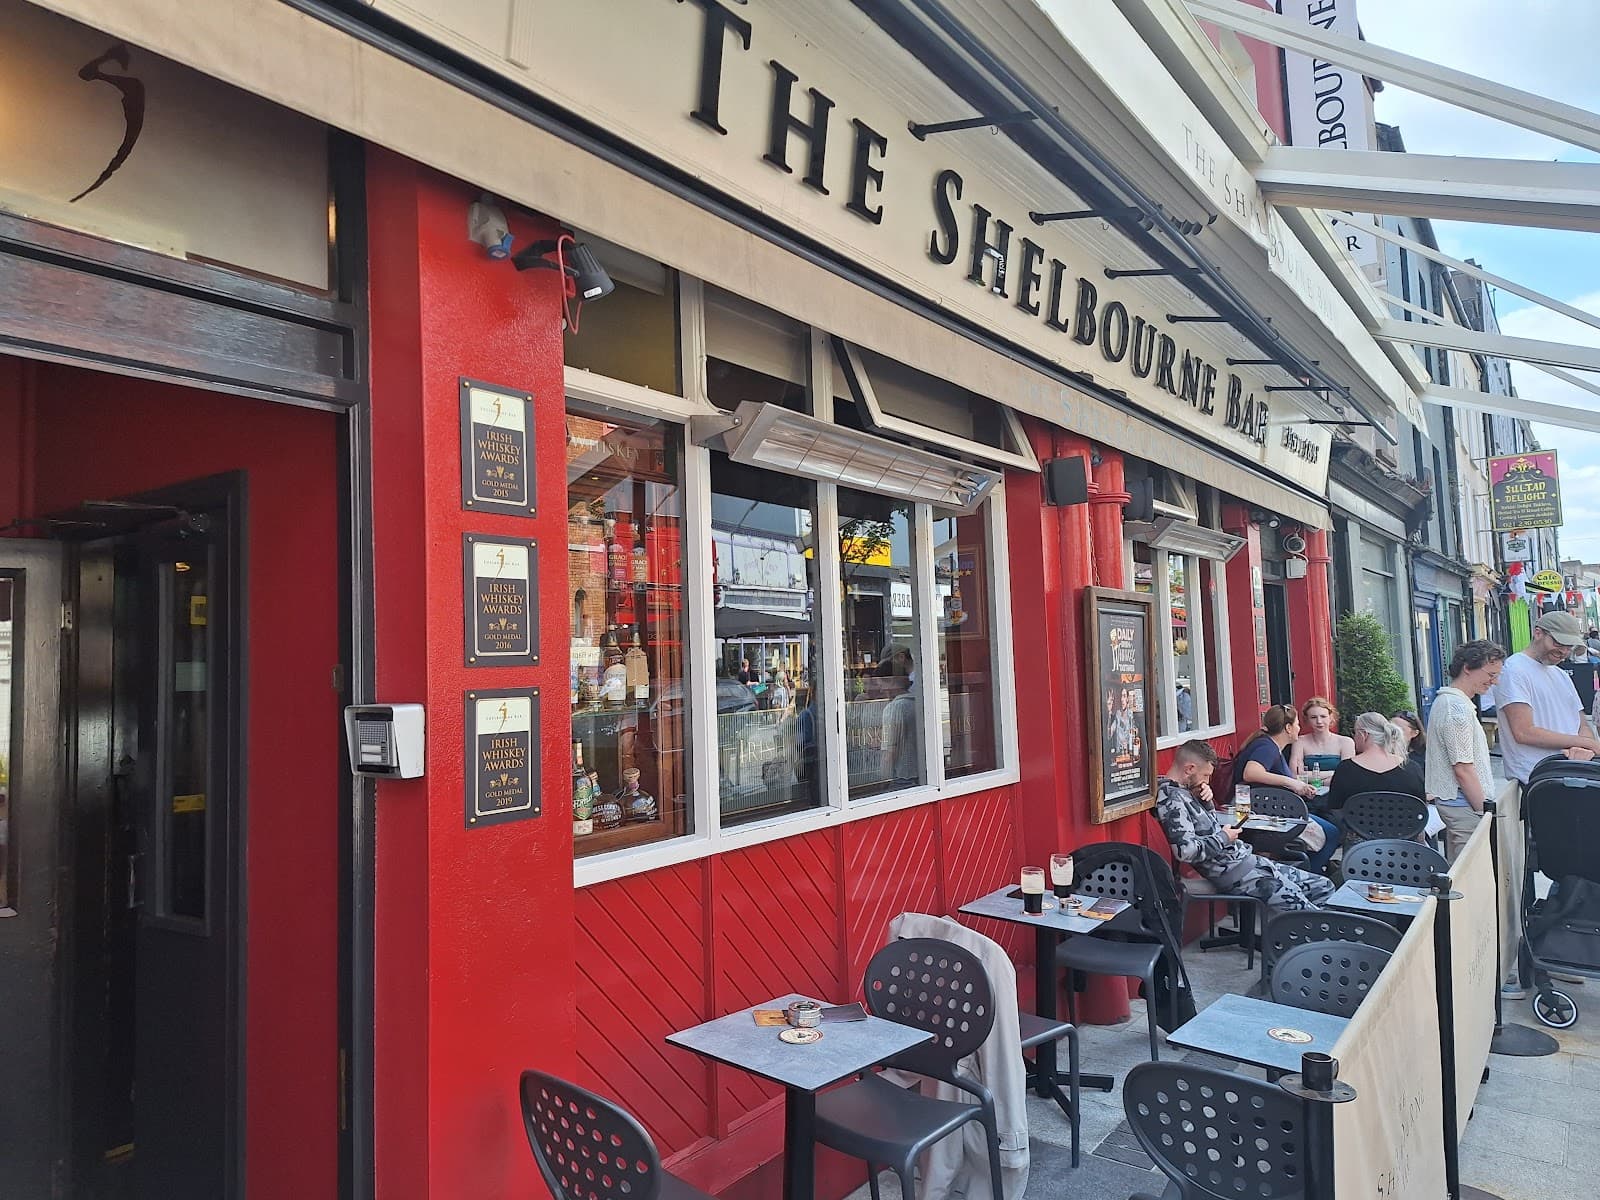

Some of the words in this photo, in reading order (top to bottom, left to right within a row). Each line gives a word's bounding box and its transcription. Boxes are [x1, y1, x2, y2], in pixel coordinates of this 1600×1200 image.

[1182, 122, 1216, 188] THE
[675, 0, 888, 225] THE
[930, 169, 1218, 416] SHELBOURNE
[1224, 374, 1269, 448] BAR
[486, 430, 512, 443] IRISH
[478, 439, 521, 456] WHISKEY
[480, 451, 519, 465] AWARDS
[482, 479, 499, 487] GOLD
[500, 481, 519, 489] MEDAL
[1505, 481, 1546, 494] SULTAN
[493, 488, 509, 497] 2015
[1504, 491, 1547, 503] DELIGHT
[489, 583, 516, 593] IRISH
[481, 593, 524, 604] WHISKEY
[483, 604, 522, 615] AWARDS
[1117, 628, 1135, 640] DAILY
[495, 641, 512, 649] 2016
[491, 738, 518, 749] IRISH
[482, 748, 526, 761] WHISKEY
[484, 759, 524, 772] AWARDS
[485, 790, 502, 798] GOLD
[504, 788, 524, 796] MEDAL
[496, 797, 513, 806] 2019
